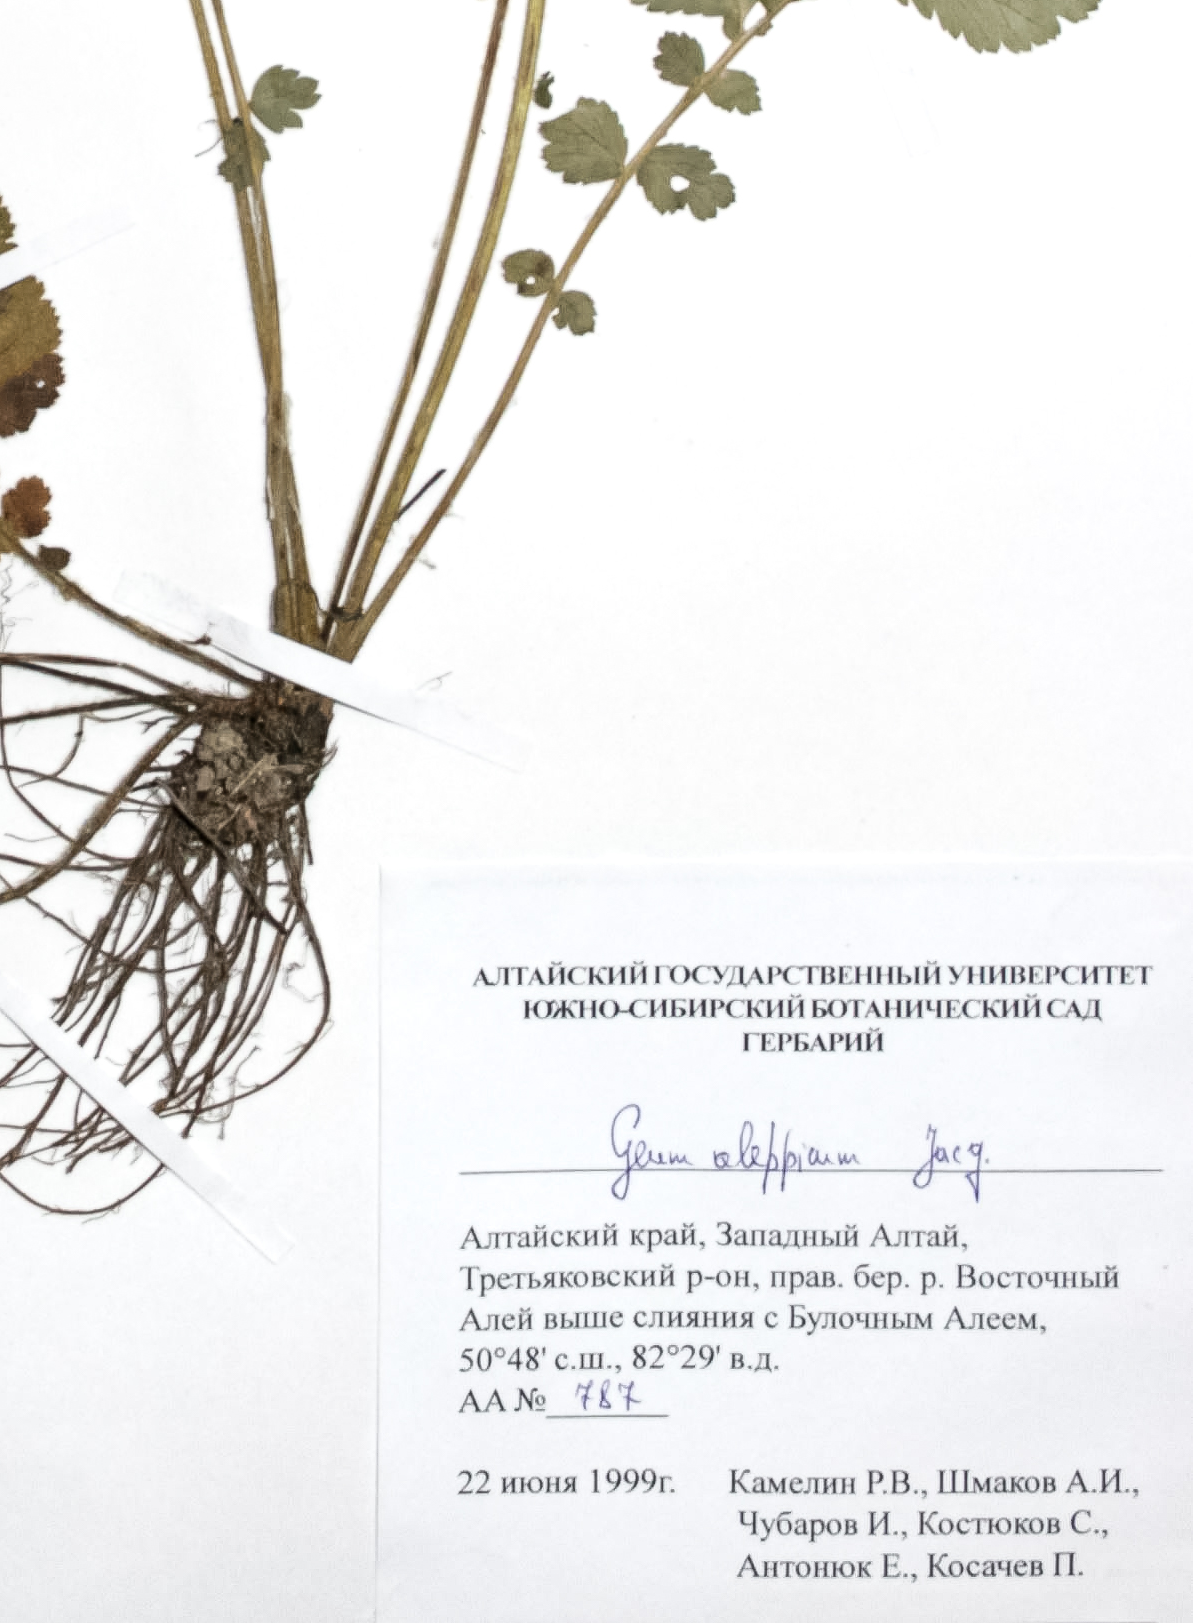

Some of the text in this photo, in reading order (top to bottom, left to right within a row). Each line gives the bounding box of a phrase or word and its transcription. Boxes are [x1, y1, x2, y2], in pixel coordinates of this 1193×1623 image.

[472, 962, 1154, 988] АЛТАЙСКИЙ ГОСУДАРСТВЕННЫЙ УНИВЕРСИТЕТ
[523, 993, 1103, 1022] ЮЖНО-СИБИРСКИЙ БОТАНИЧЕСКИЙ САД
[742, 1027, 884, 1053] ГЕРБАРИЙ
[611, 1104, 693, 1200] Geum
[459, 1221, 968, 1254] Алтайский край, Западный Алтай,
[459, 1263, 1120, 1297] Третьяковский р-он, прав. бер. р. Восточный
[458, 1304, 1047, 1337] Алей выше слияния с Булочным Алеем,
[554, 1352, 622, 1374] с.ш.,
[729, 1352, 779, 1373] в.д.
[513, 1387, 547, 1413] №
[575, 1379, 642, 1411] 787
[457, 1468, 676, 1495] 22 июня 1999г.
[729, 1468, 1140, 1499] Камелин Р.В., Шмаков А.И.,
[738, 1510, 1109, 1543] Чубаров И., Костюков С.,
[736, 1551, 1084, 1584] Антонюк Е., Косачев П.
